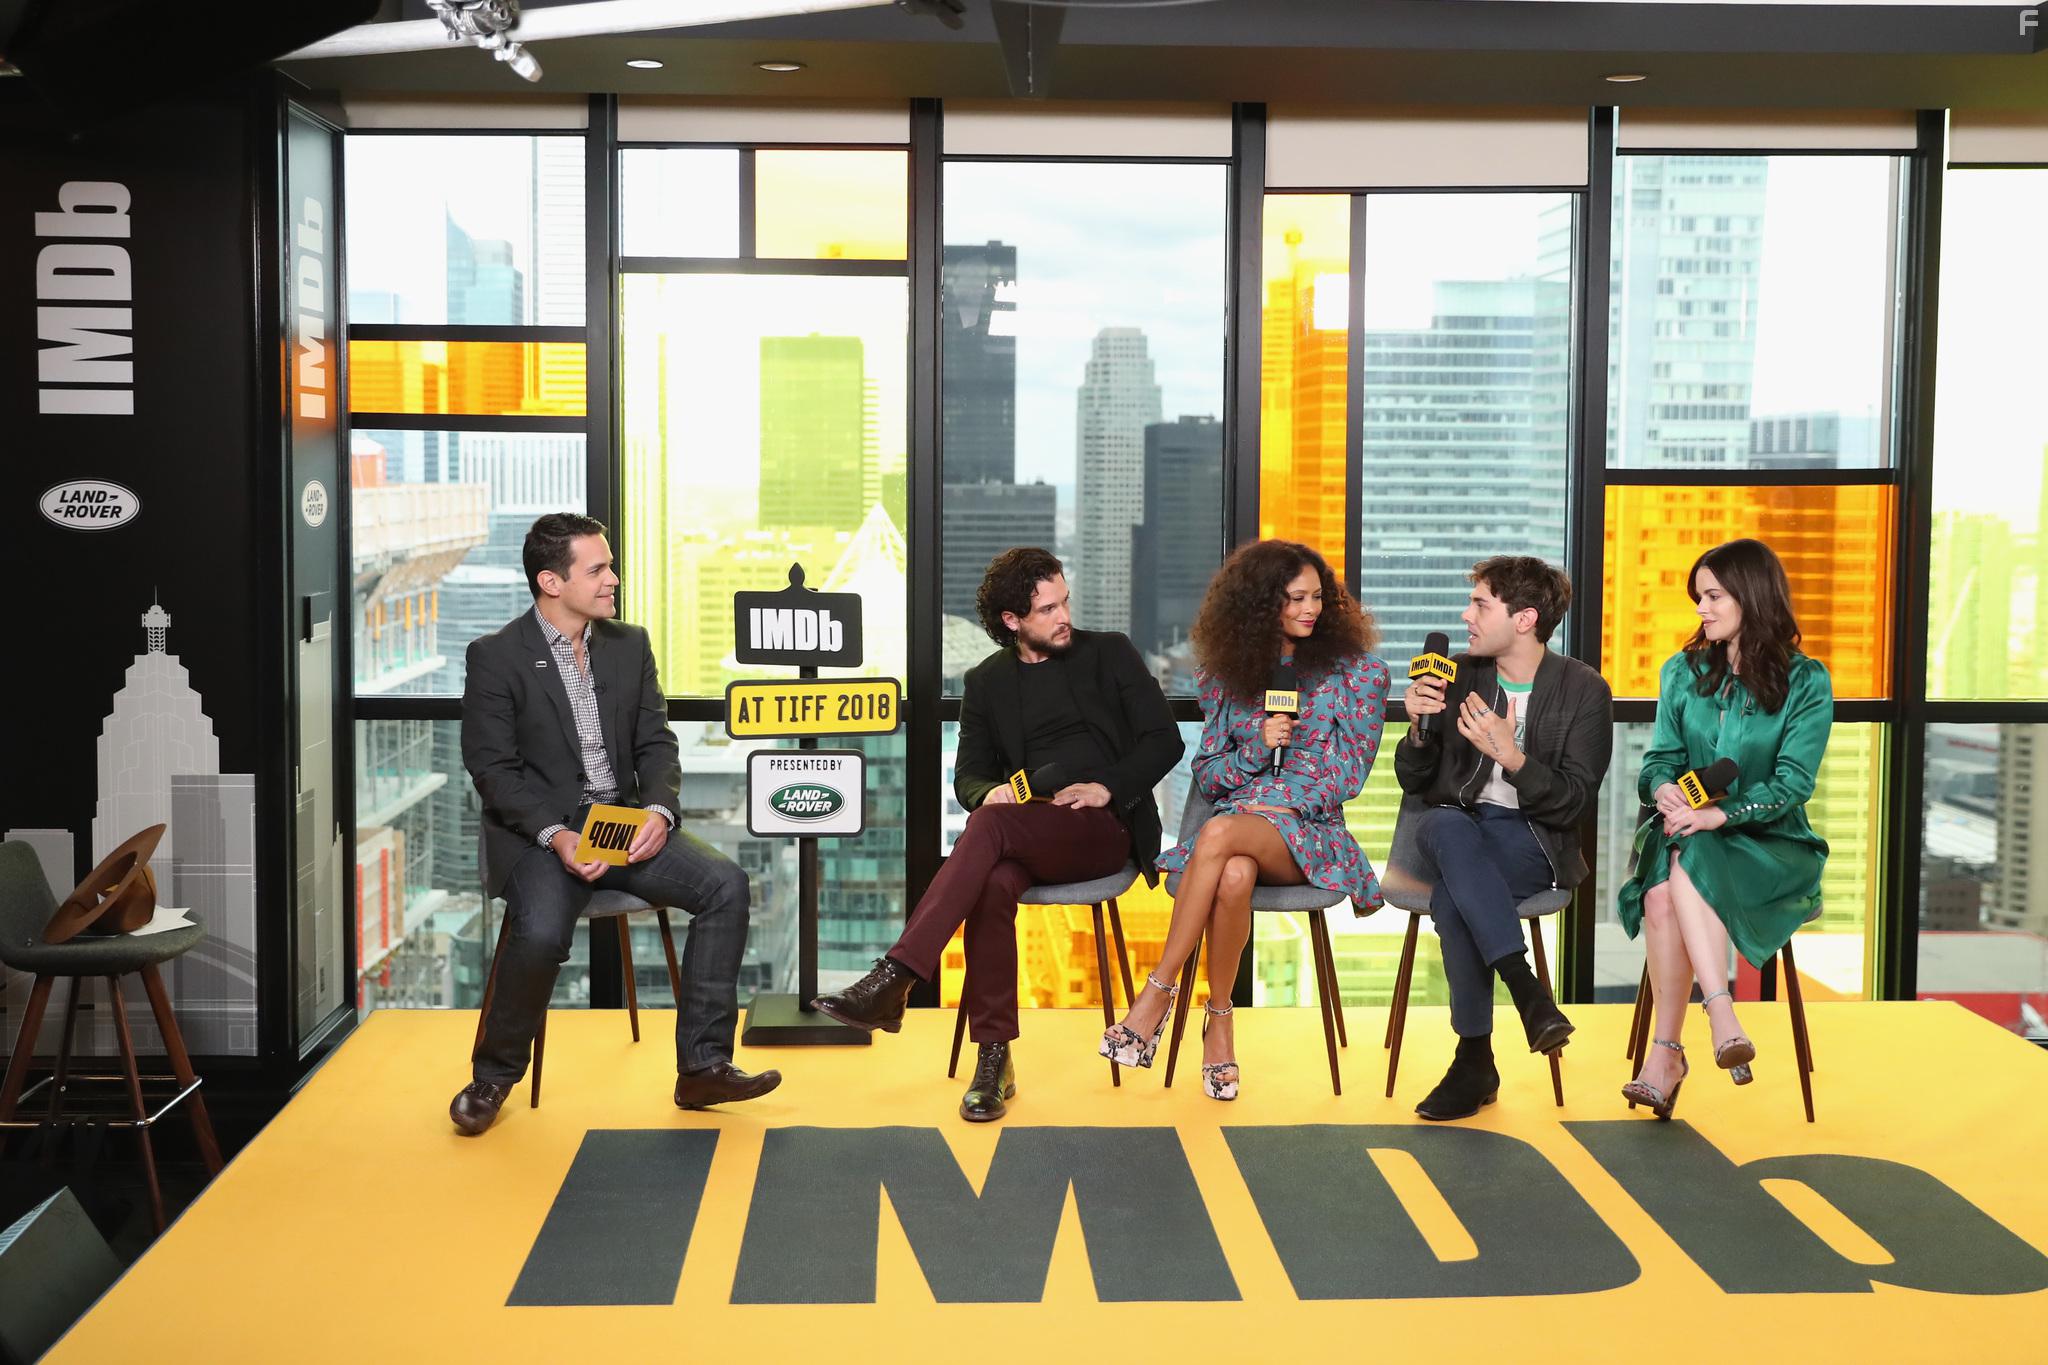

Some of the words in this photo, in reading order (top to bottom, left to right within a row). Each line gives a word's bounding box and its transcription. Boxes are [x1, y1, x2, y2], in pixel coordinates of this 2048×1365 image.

[35, 181, 134, 415] IMDb
[298, 197, 326, 419] IMDb
[59, 490, 108, 504] LAND
[63, 506, 122, 519] ROVER
[750, 608, 843, 652] IMDb
[1410, 659, 1430, 672] IMDb
[1433, 658, 1454, 677] IMDb
[738, 697, 764, 723] AT
[774, 695, 827, 723] TIFF
[837, 693, 890, 721] 2018
[1268, 695, 1295, 707] IMDb
[783, 790, 821, 801] LAND
[1014, 774, 1027, 801] IMDb
[1682, 776, 1702, 804] IMDb
[785, 801, 833, 812] ROVER
[588, 820, 638, 851] IMDb
[505, 1119, 2048, 1307] IMDb
